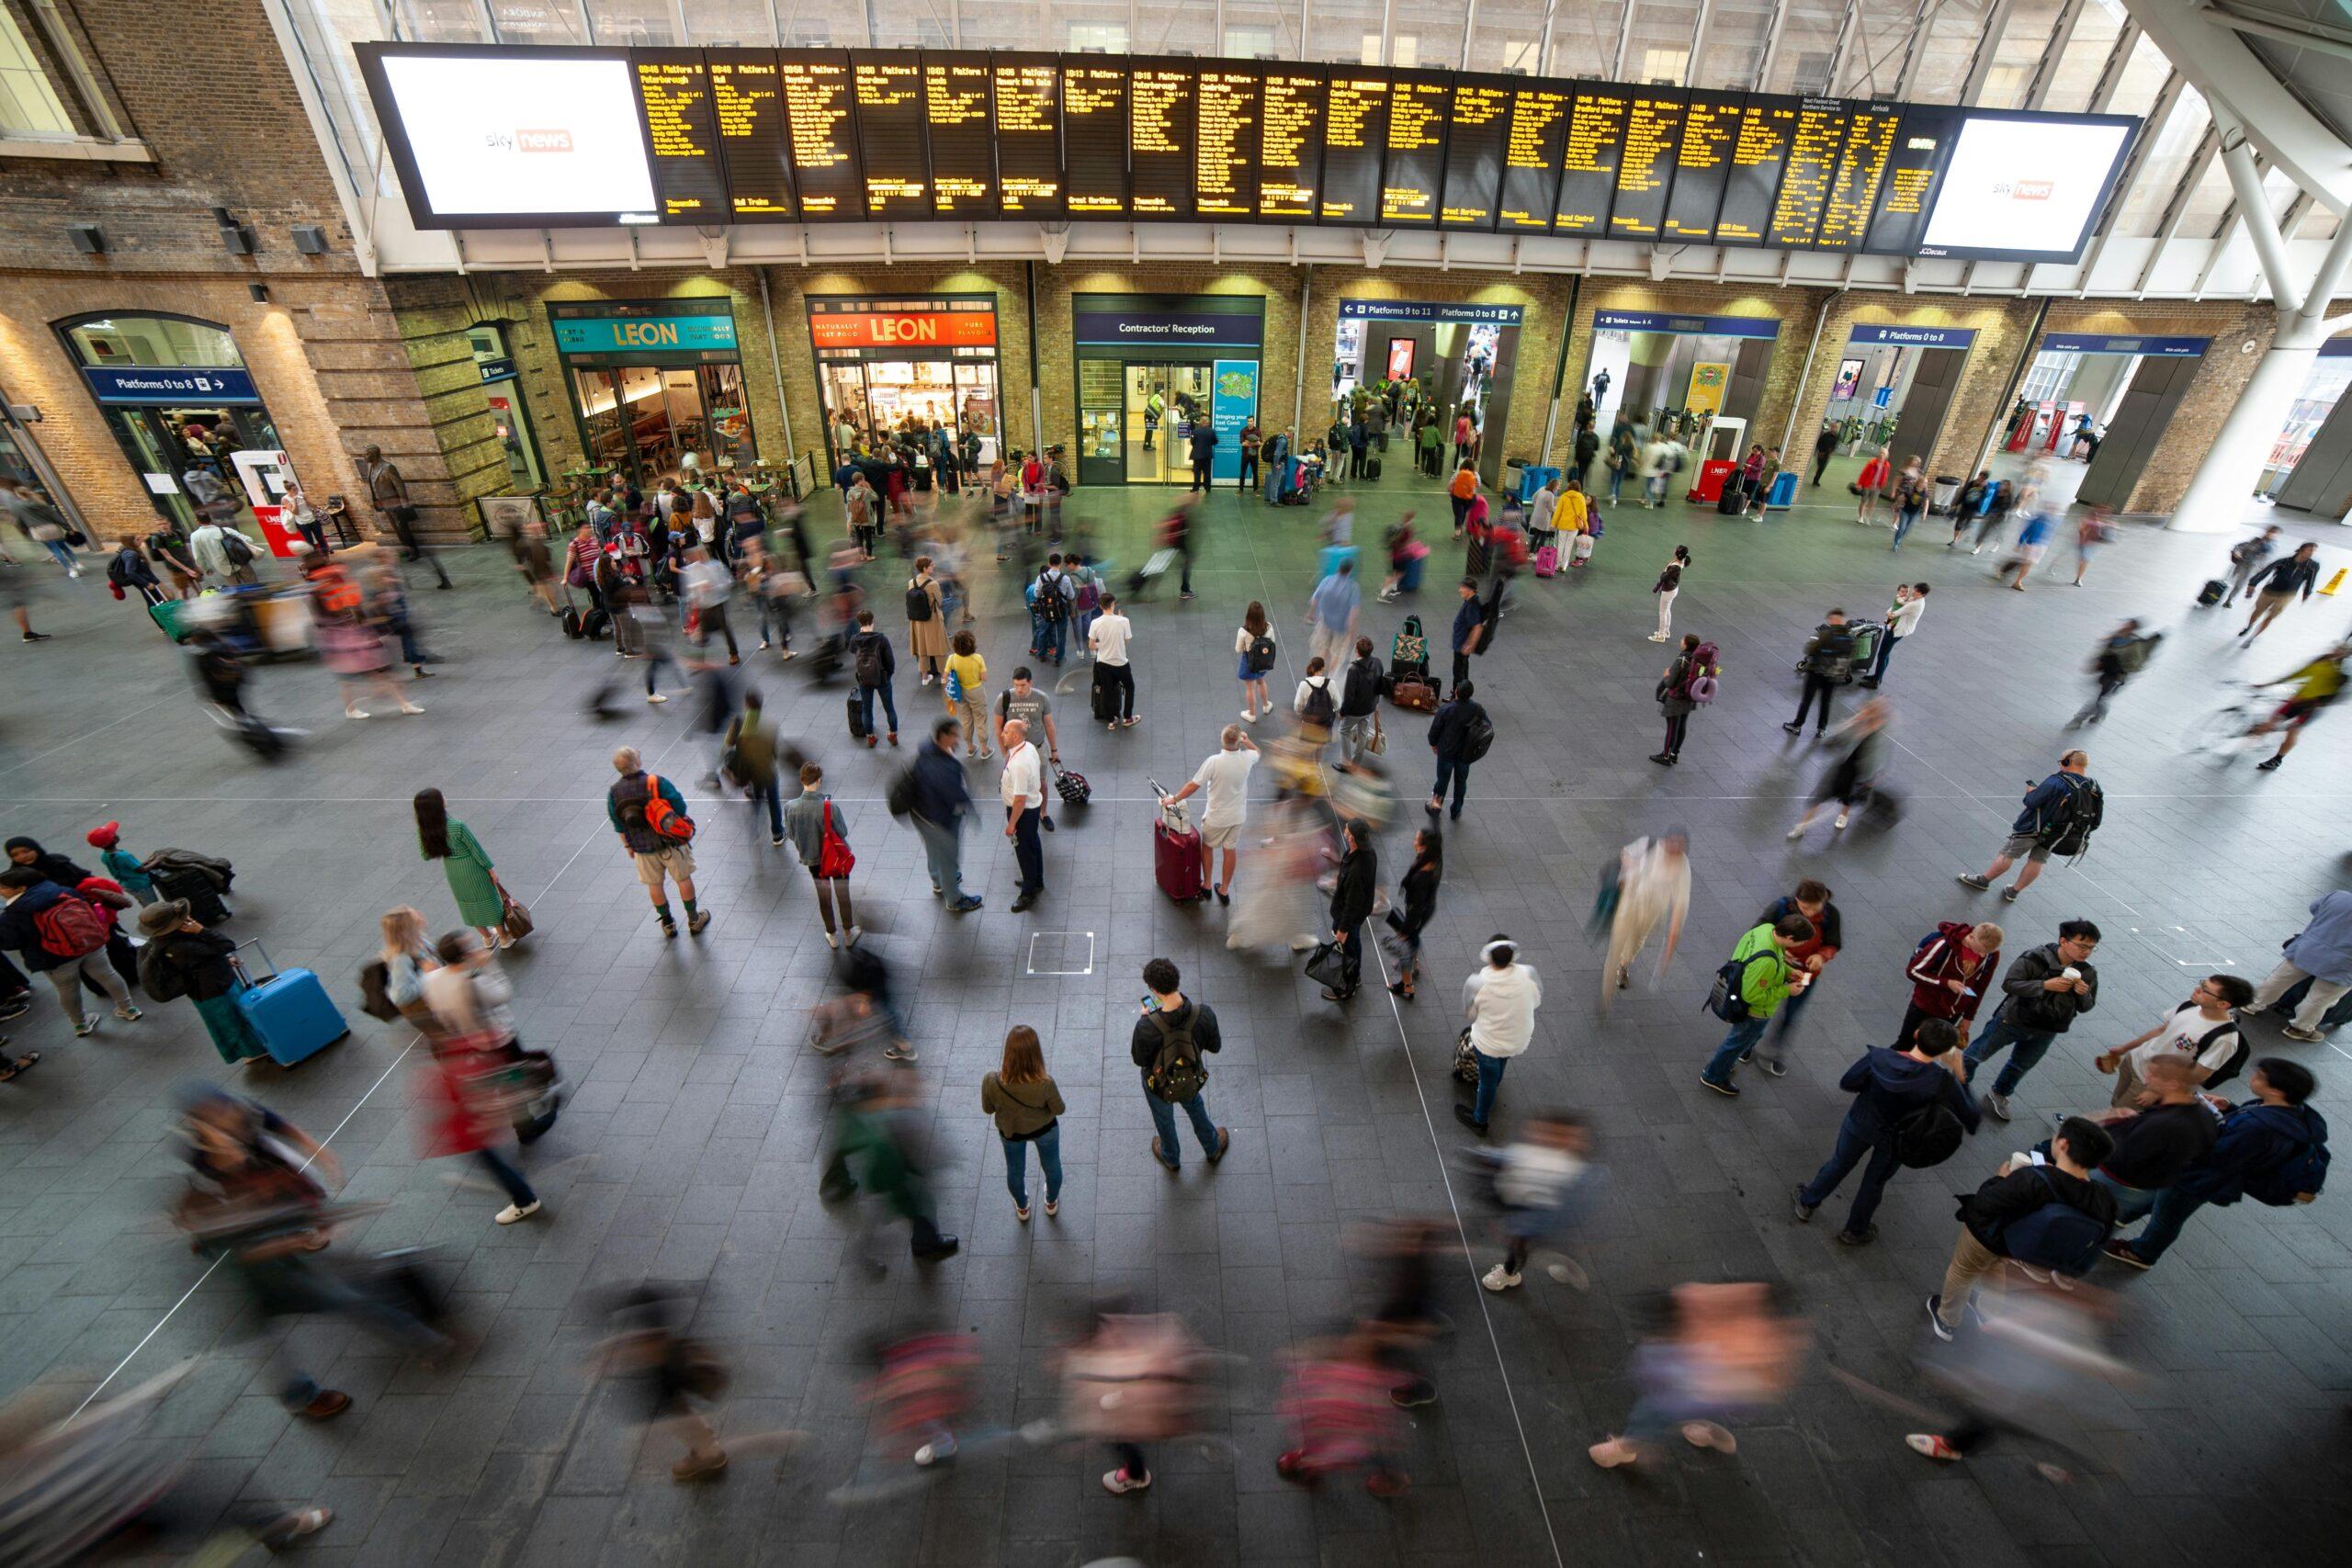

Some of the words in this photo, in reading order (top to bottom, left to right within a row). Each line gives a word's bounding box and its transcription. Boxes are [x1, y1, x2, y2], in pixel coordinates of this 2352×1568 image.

[663, 65, 693, 73] Platform
[739, 65, 768, 73] Platform
[810, 65, 839, 73] Platform
[882, 66, 910, 74] Platform
[953, 67, 981, 75] Platform
[1022, 68, 1049, 76] Platform
[1091, 70, 1118, 78] Platform
[1158, 73, 1185, 81] Platform
[1225, 74, 1251, 83] Platform
[640, 75, 689, 85] Peterborough
[856, 76, 888, 85] Aberdeen
[1066, 79, 1075, 87] Ely
[1290, 77, 1316, 86] Platform
[1133, 81, 1177, 90] Peterborough
[1200, 84, 1231, 92] Cambridge
[1417, 85, 1442, 93] Platform
[1265, 86, 1295, 96] Edinburgh
[1330, 90, 1360, 98] Cambridge
[1479, 88, 1503, 97] Platform
[1393, 93, 1411, 101] Leeds
[1462, 97, 1490, 106] Cambridge
[1539, 93, 1562, 101] Platform
[1598, 97, 1622, 106] Platform
[1515, 100, 1555, 110] Peterborough
[1655, 101, 1678, 110] Platform
[485, 131, 513, 151] sky
[521, 133, 571, 148] news
[2015, 185, 2051, 197] news
[748, 198, 769, 207] Trains
[1068, 197, 1087, 205] Great
[1089, 197, 1118, 205] Northern
[1918, 248, 1947, 256] JCDecaux
[1368, 306, 1403, 315] Platforms
[1405, 307, 1410, 315] 9
[1441, 309, 1475, 318] Platforms
[1481, 310, 1489, 318] to
[870, 318, 936, 341] LEON
[1119, 323, 1170, 333] Contractors'
[1172, 324, 1215, 334] Reception
[612, 322, 679, 345] LEON
[1890, 331, 1923, 341] Platforms
[1939, 333, 1944, 342] 8
[489, 367, 504, 376] Tickets
[116, 378, 164, 389] Platforms
[164, 380, 172, 389] 0
[173, 380, 185, 389] to
[185, 381, 194, 389] 8
